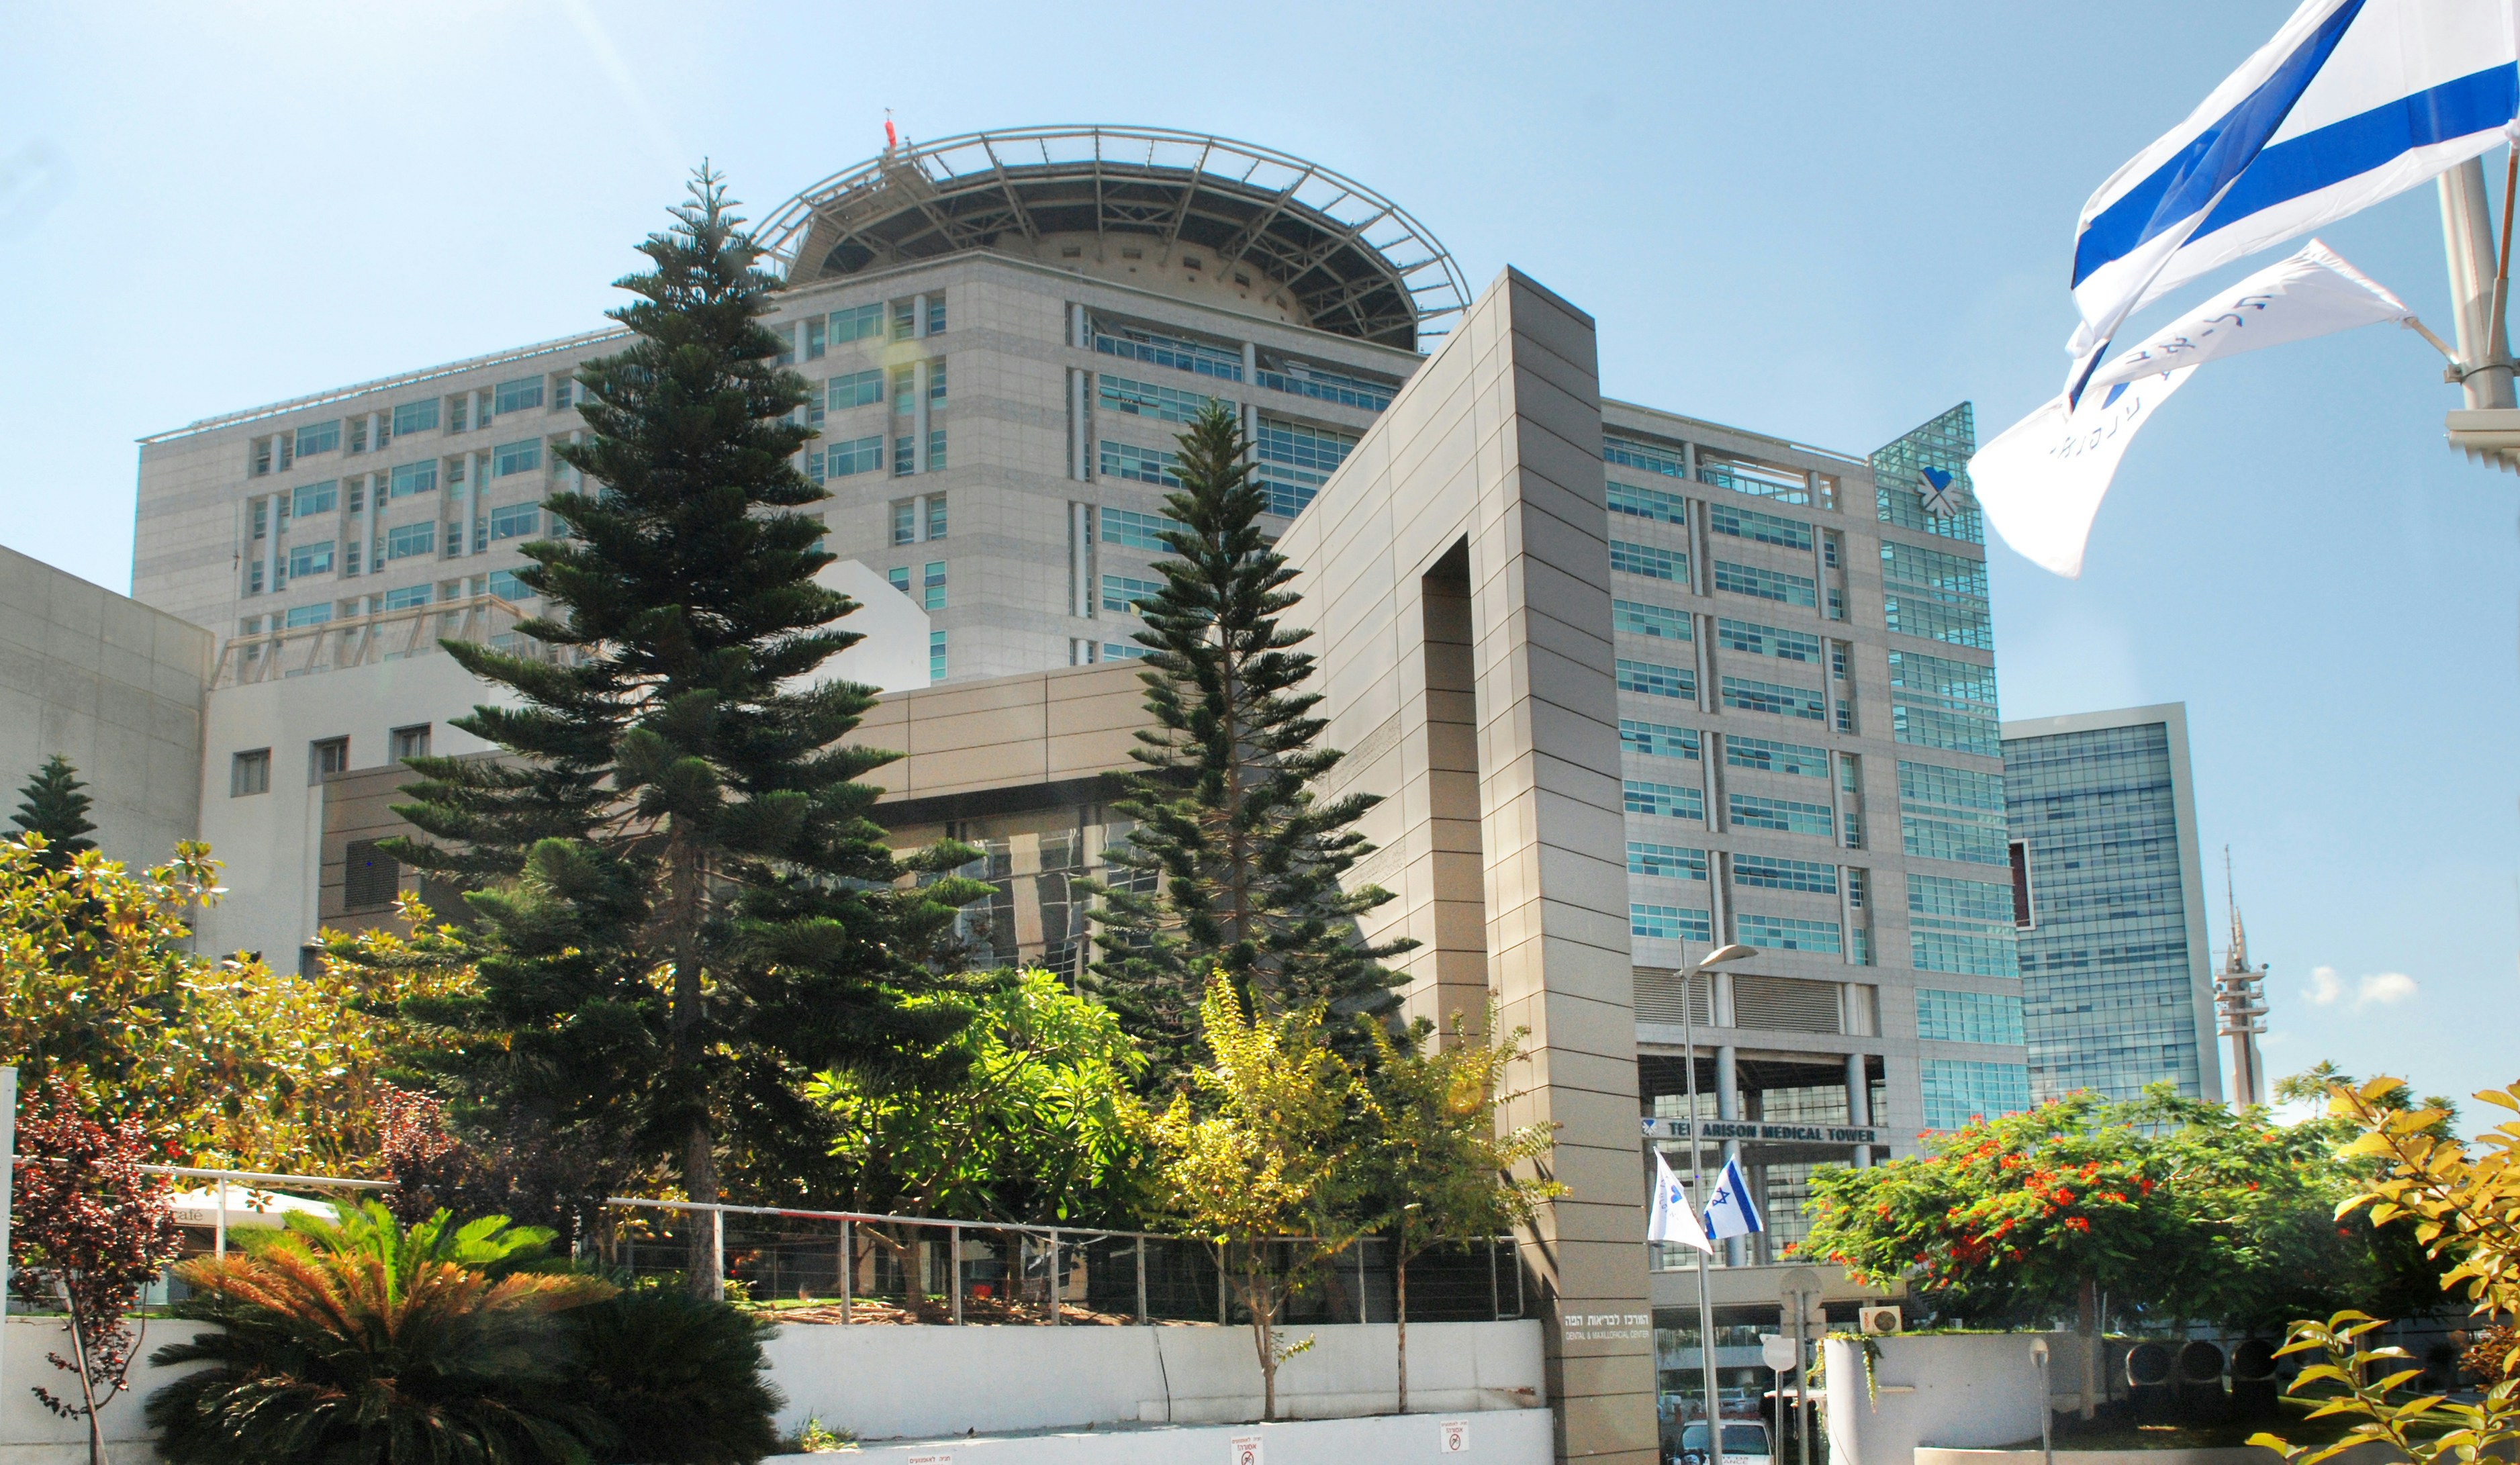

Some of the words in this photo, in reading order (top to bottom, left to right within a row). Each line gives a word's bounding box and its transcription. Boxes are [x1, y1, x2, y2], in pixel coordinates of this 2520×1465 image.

[1703, 1123, 1757, 1138] ARISON
[1761, 1125, 1824, 1140] MEDICAL
[1826, 1128, 1875, 1142] TOWER
[1565, 1315, 1583, 1326] הפה
[1587, 1313, 1620, 1326] לבריאות
[1624, 1315, 1648, 1325] המרכז
[1565, 1331, 1586, 1340] DENTAL
